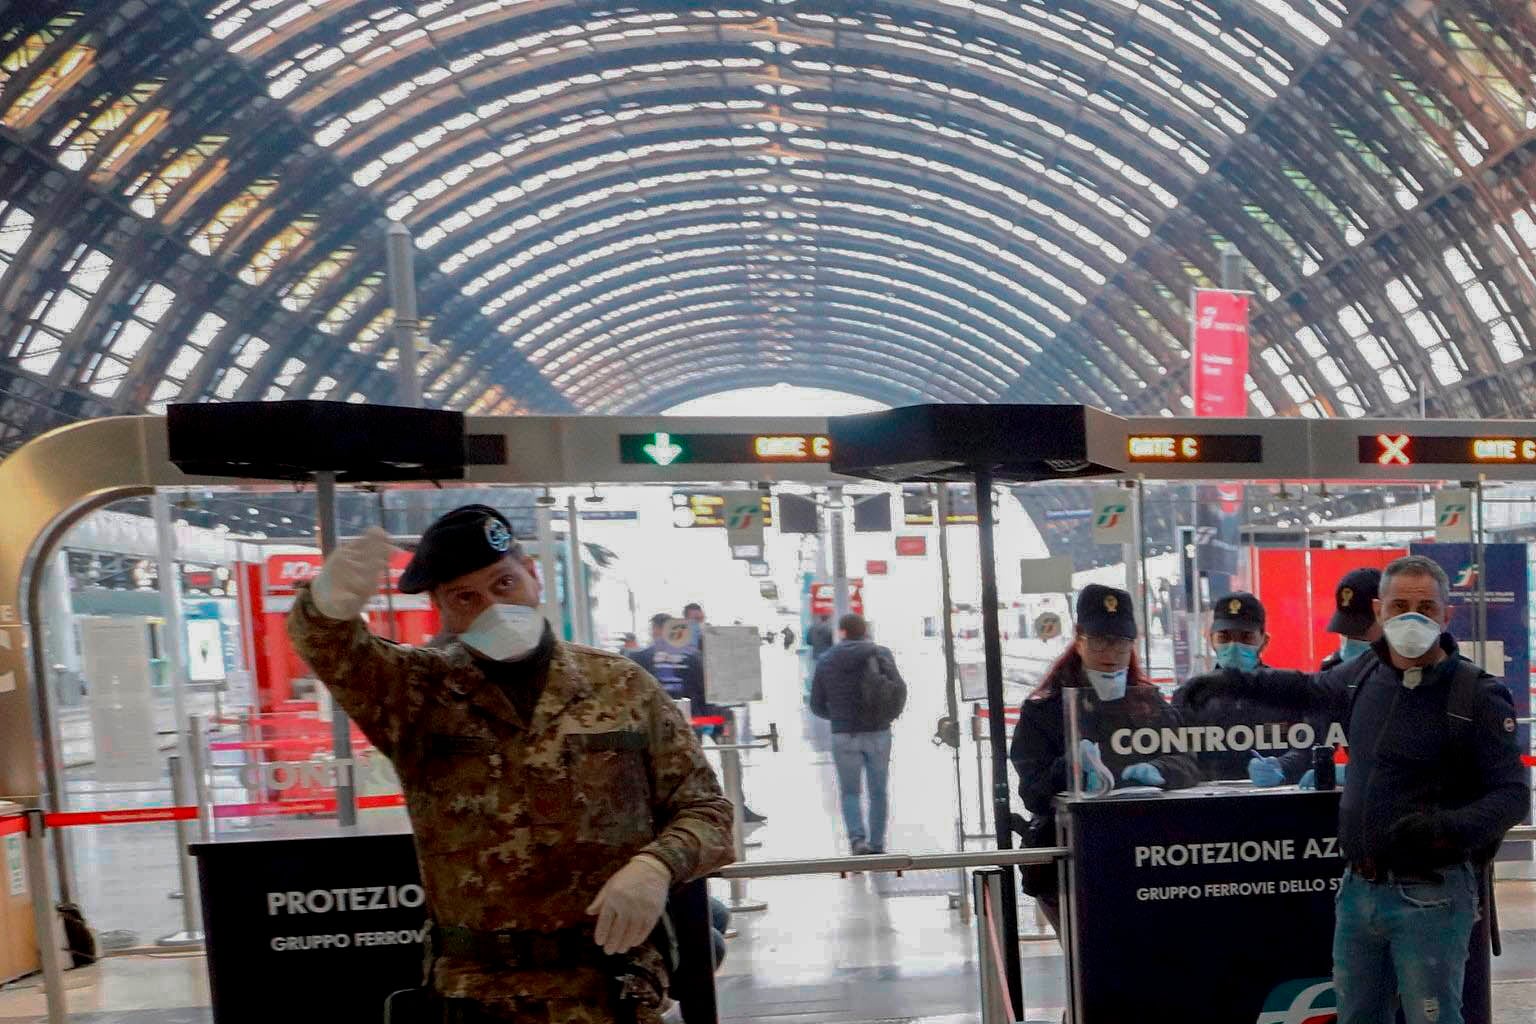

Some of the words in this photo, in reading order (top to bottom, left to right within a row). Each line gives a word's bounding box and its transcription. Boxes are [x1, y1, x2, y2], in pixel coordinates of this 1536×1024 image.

[1110, 722, 1315, 756] CONTROLLO
[1324, 721, 1349, 748] A
[1135, 838, 1295, 868] PROTEZIONE
[267, 884, 426, 916] PROTEZIO
[1136, 884, 1202, 901] GRUPPO
[1204, 880, 1276, 897] FERROVIE
[1280, 877, 1326, 895] DELLO
[270, 933, 350, 952] GRUPPO
